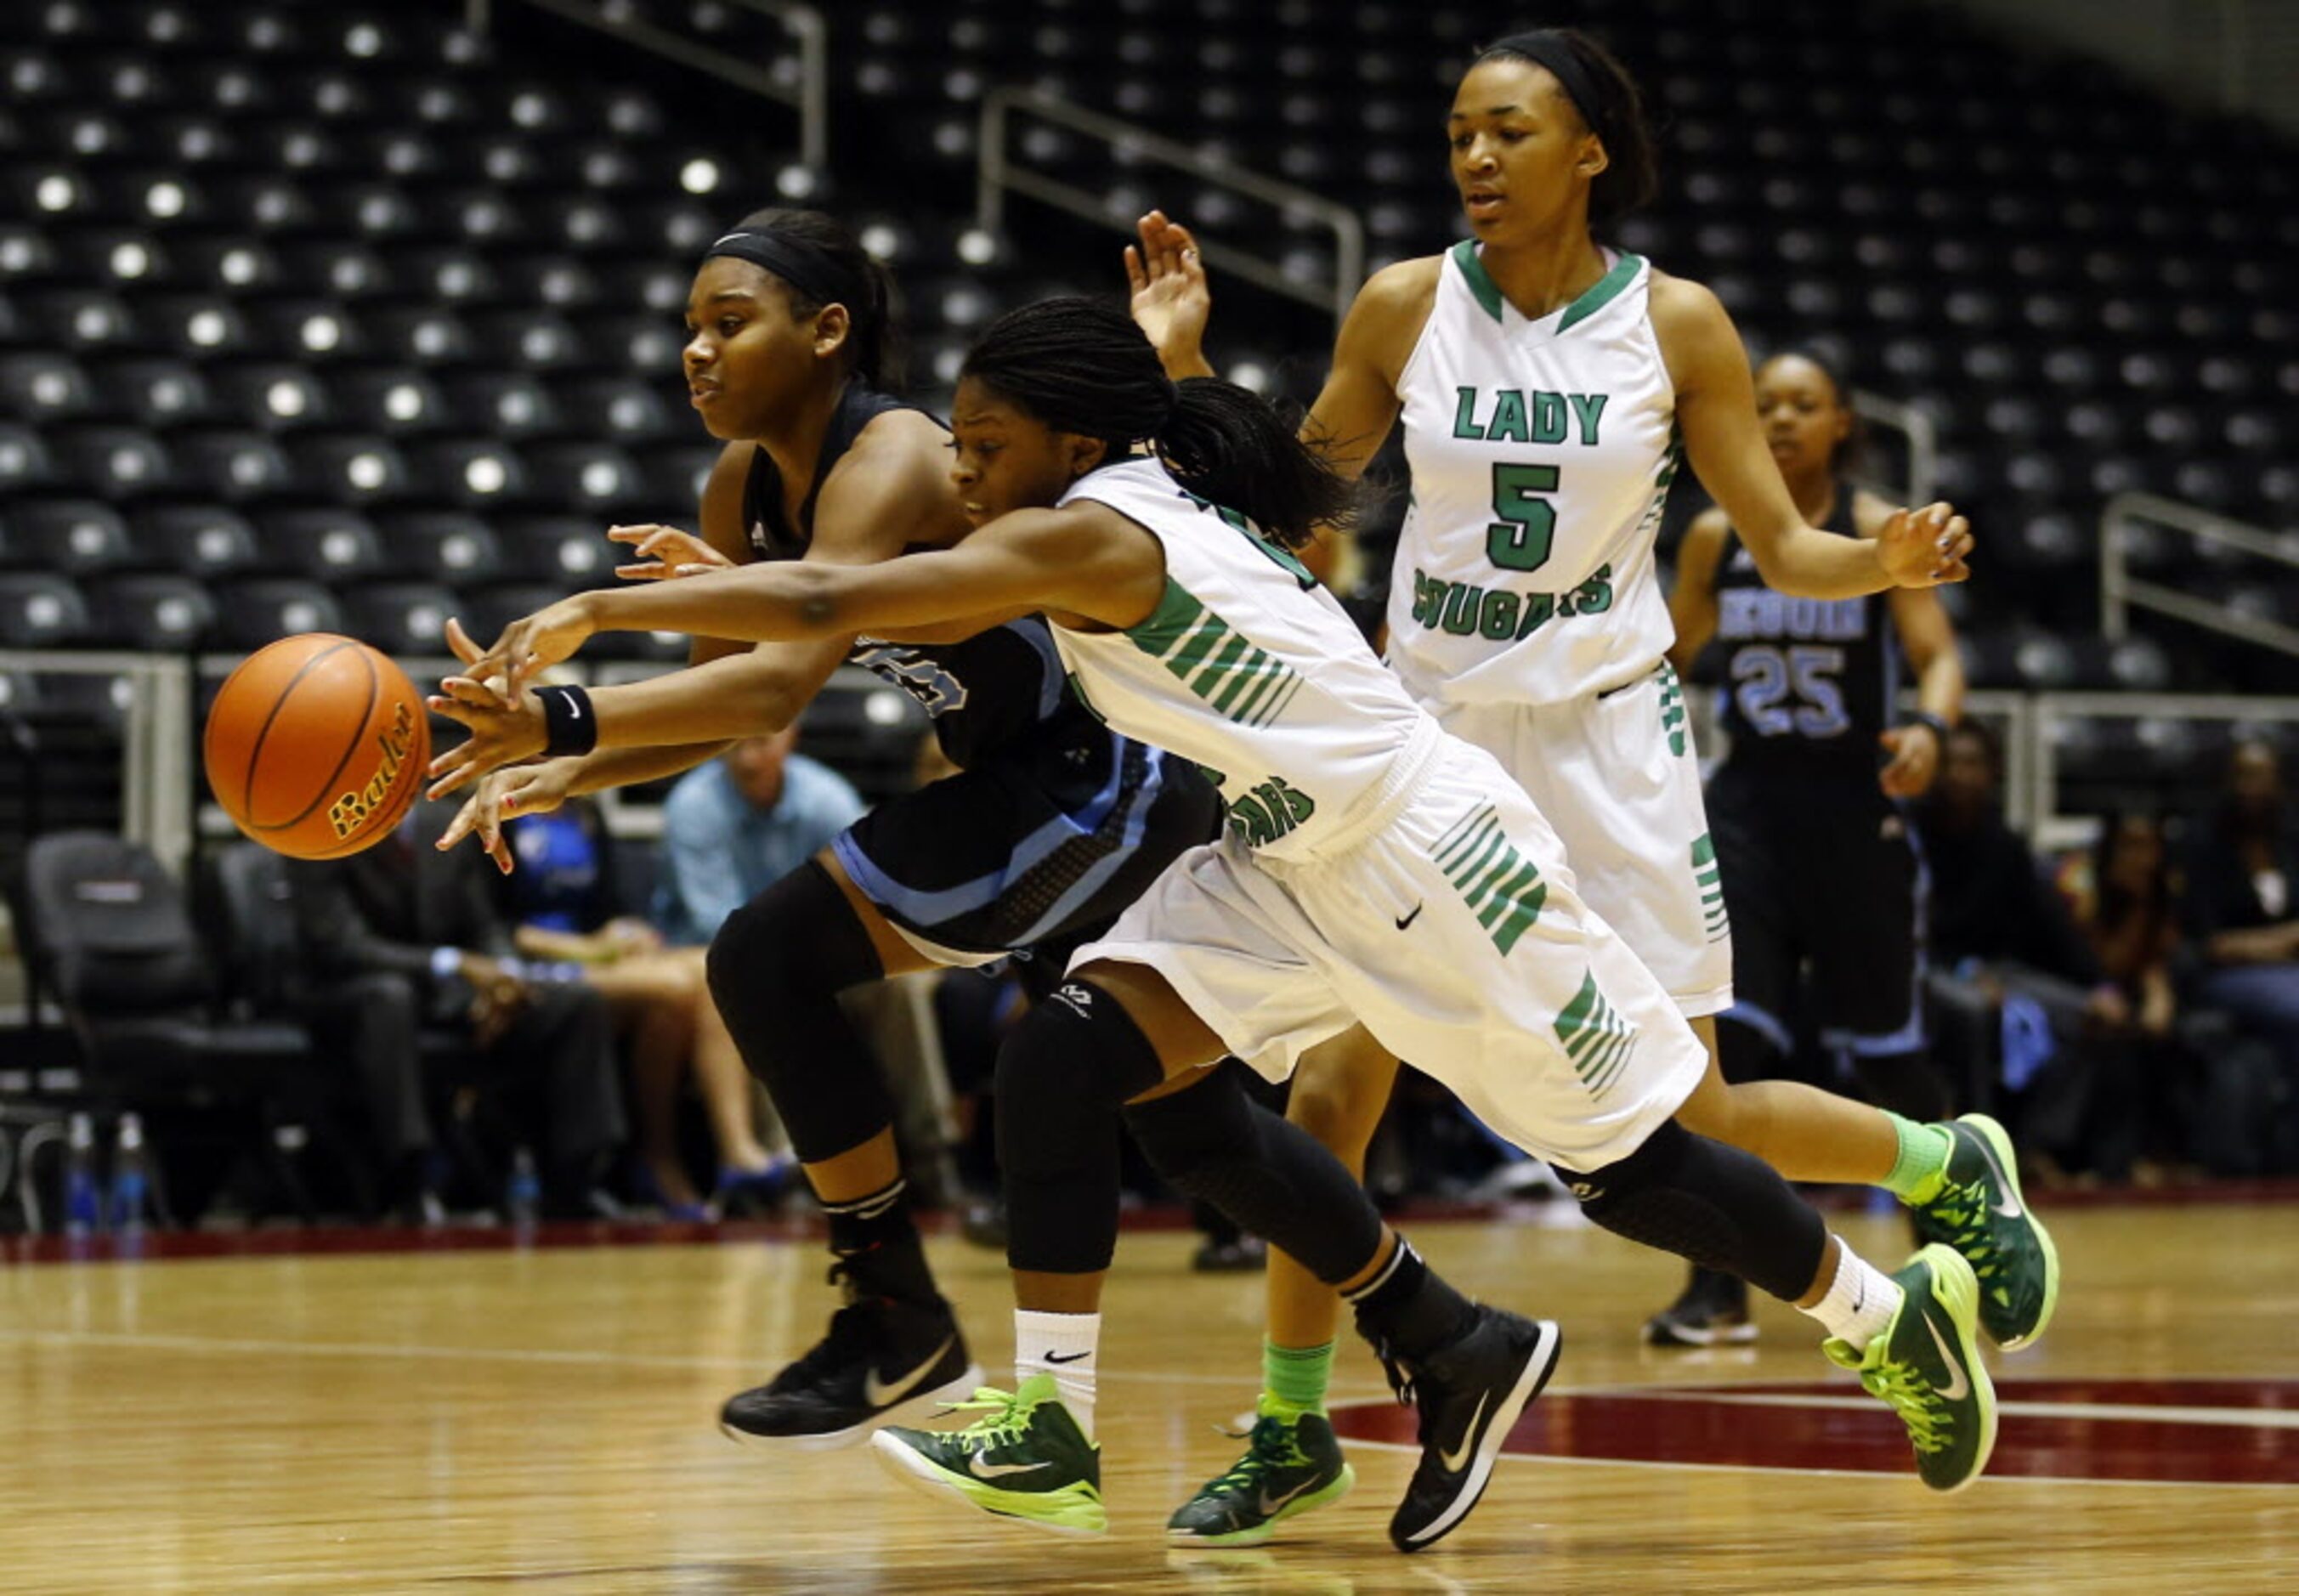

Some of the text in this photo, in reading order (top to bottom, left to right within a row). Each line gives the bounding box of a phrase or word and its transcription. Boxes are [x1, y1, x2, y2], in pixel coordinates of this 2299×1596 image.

[1452, 387, 1609, 446] LADY
[1486, 461, 1560, 573] 5
[1730, 643, 1851, 738] 25
